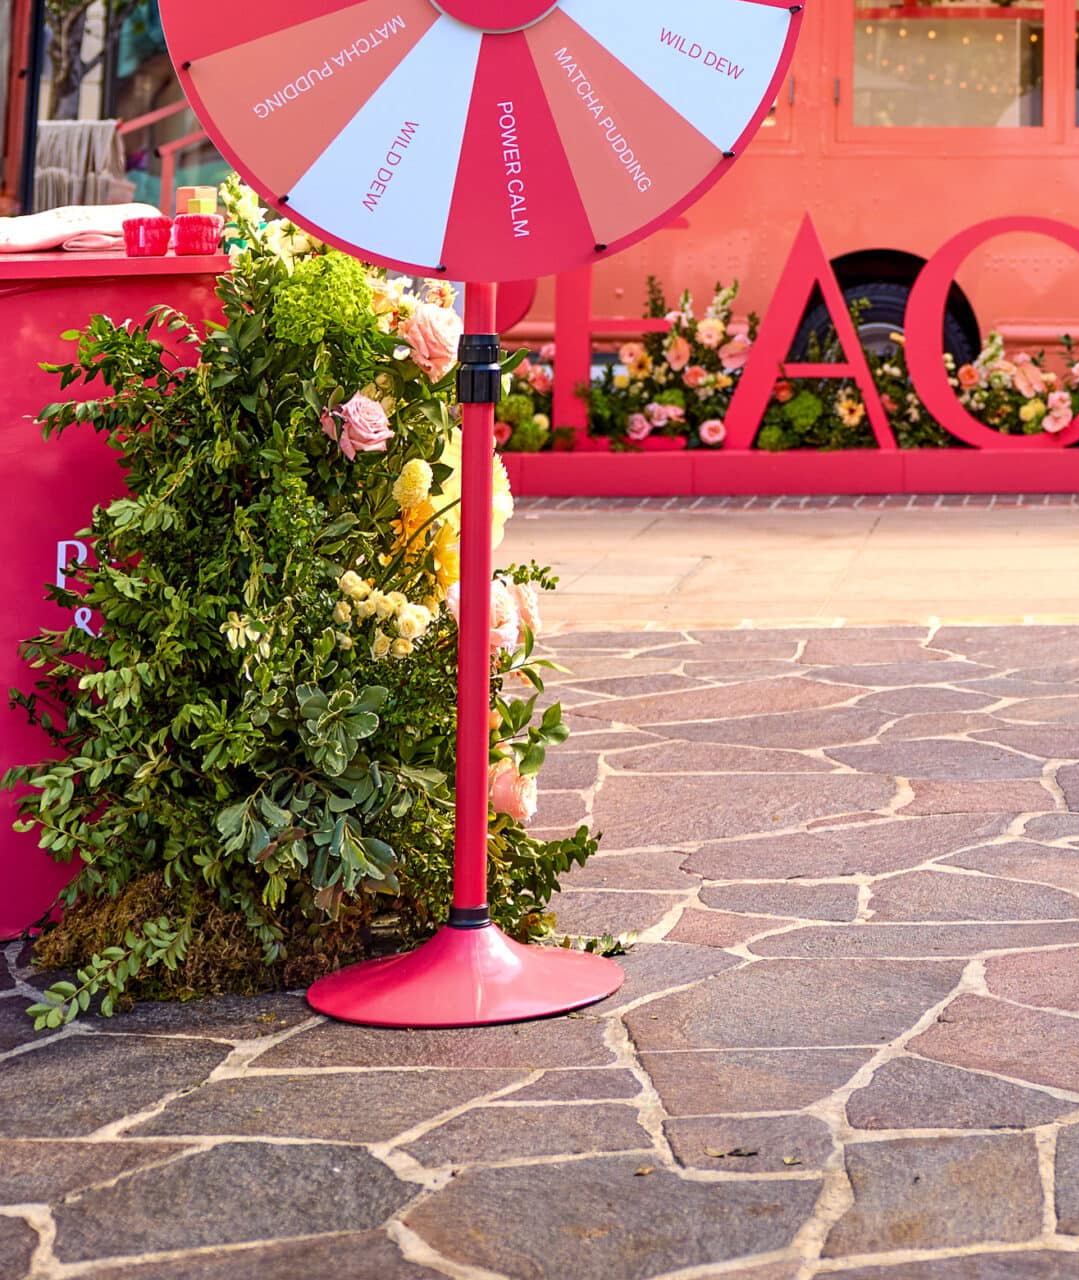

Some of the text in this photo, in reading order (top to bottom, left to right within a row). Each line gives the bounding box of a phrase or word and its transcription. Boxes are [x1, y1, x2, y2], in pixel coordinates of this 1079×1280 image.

[253, 15, 406, 118] MATCHA PUDDING
[659, 27, 745, 80] WILD DEW
[362, 121, 420, 212] WILD DEW
[497, 101, 530, 238] POWER CALM
[554, 47, 652, 193] MATCHA PUDDING
